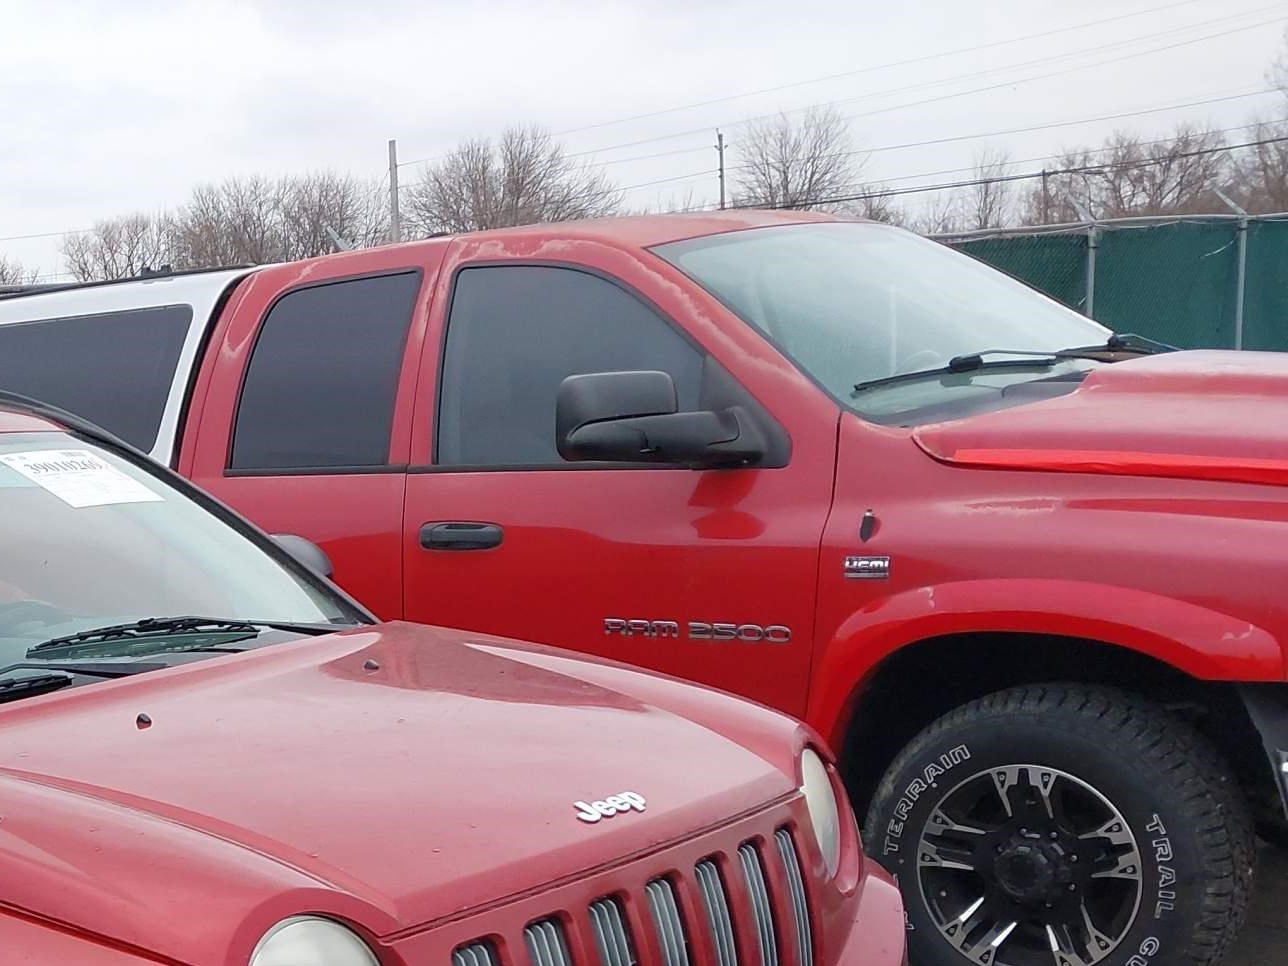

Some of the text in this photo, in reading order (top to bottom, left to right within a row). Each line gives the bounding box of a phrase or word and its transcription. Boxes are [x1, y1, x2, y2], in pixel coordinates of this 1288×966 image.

[603, 617, 792, 643] RAM 2500
[573, 791, 647, 824] Jeep
[883, 744, 971, 855] TERRAIN
[1145, 813, 1176, 920] TRAIL
